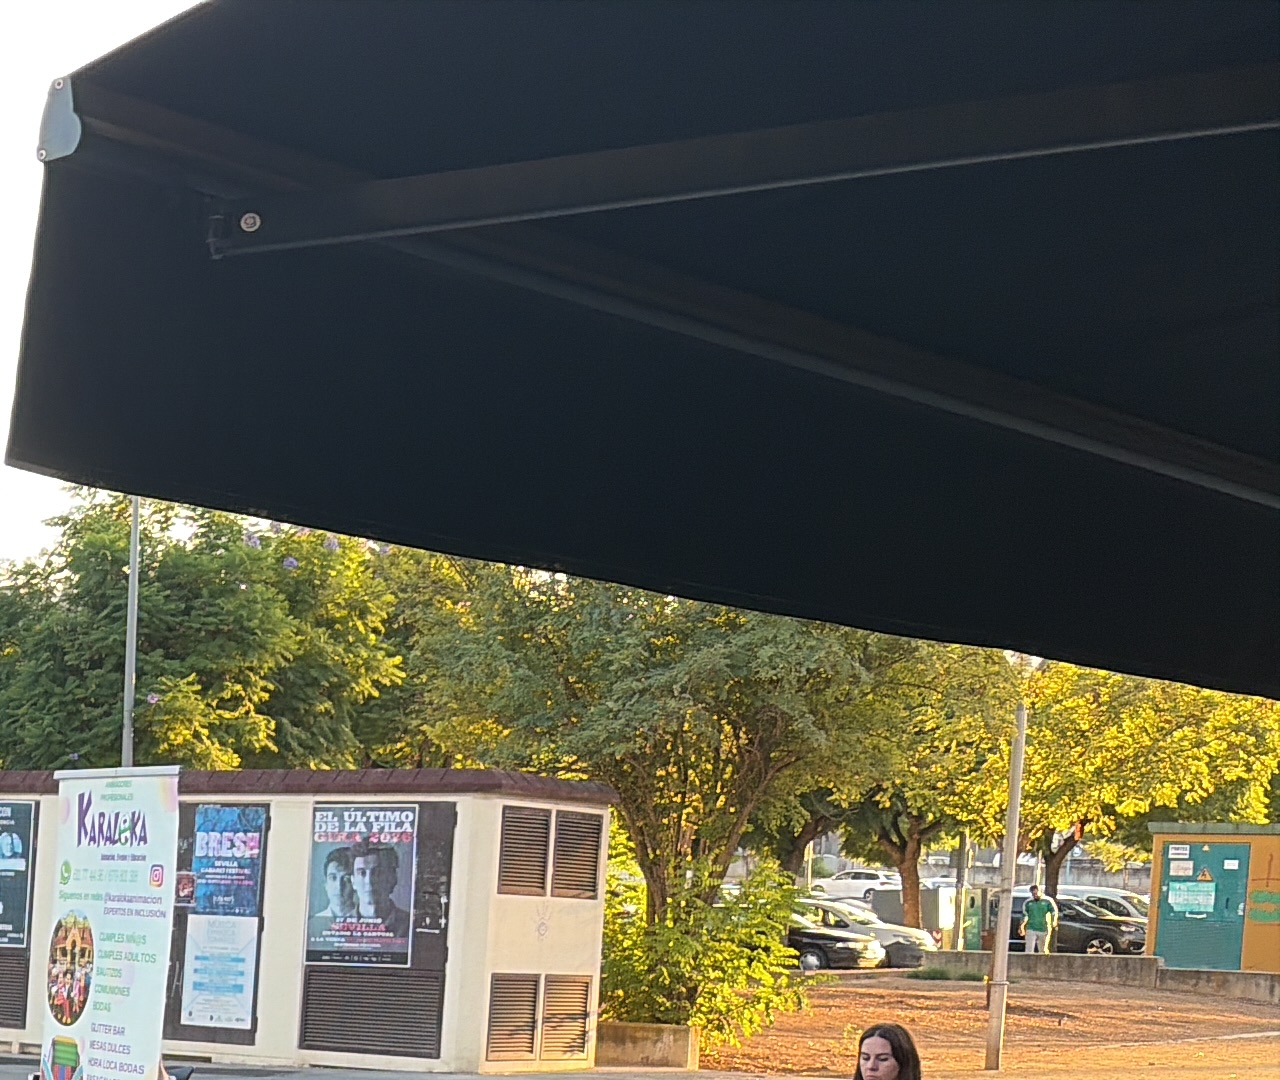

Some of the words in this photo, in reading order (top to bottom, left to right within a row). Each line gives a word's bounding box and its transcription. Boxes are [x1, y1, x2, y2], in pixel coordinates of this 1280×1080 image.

[315, 811, 338, 822] EL
[343, 808, 414, 822] ÚLTIMO
[314, 822, 339, 832] DE
[344, 822, 368, 832] LA
[372, 822, 414, 832] FILA
[314, 832, 362, 843] GIRA
[368, 832, 413, 843] 2026
[194, 832, 260, 858] BRESH
[330, 922, 386, 931] SEVILLA
[98, 950, 123, 961] CUMPLES
[124, 952, 157, 964] ADULTOS
[94, 984, 131, 997] COMUNIONES
[92, 1001, 112, 1012] BODAS
[113, 1026, 125, 1036] BAR
[89, 1040, 107, 1051] MESAS
[108, 1042, 131, 1055] DULCES
[88, 1059, 102, 1070] HORA
[103, 1060, 118, 1072] LOCA
[118, 1061, 145, 1075] BODAS
